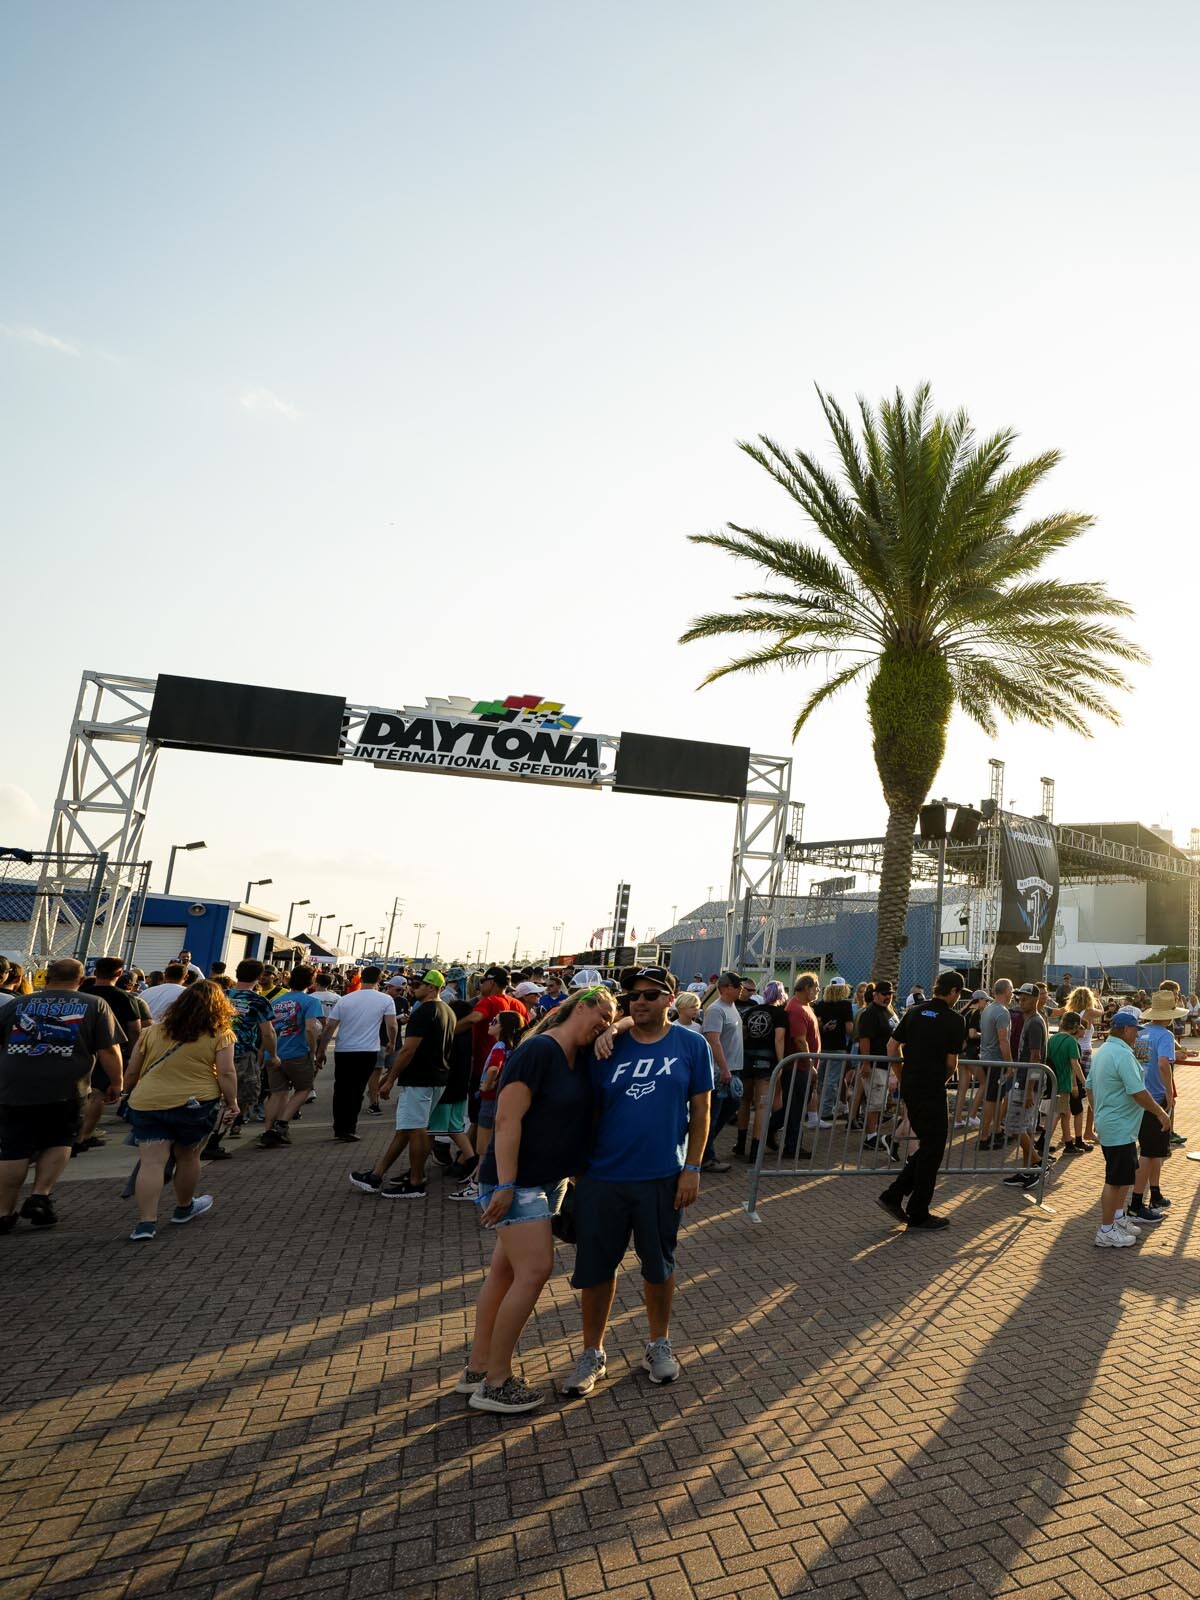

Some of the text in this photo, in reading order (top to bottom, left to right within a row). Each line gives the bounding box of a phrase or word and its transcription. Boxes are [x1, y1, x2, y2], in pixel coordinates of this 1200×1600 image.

[358, 712, 599, 768] DAYTONA
[353, 746, 598, 780] INTERNATIONAL SPEEDWAY
[16, 1003, 88, 1016] LARSON
[611, 1057, 678, 1083] FOX
